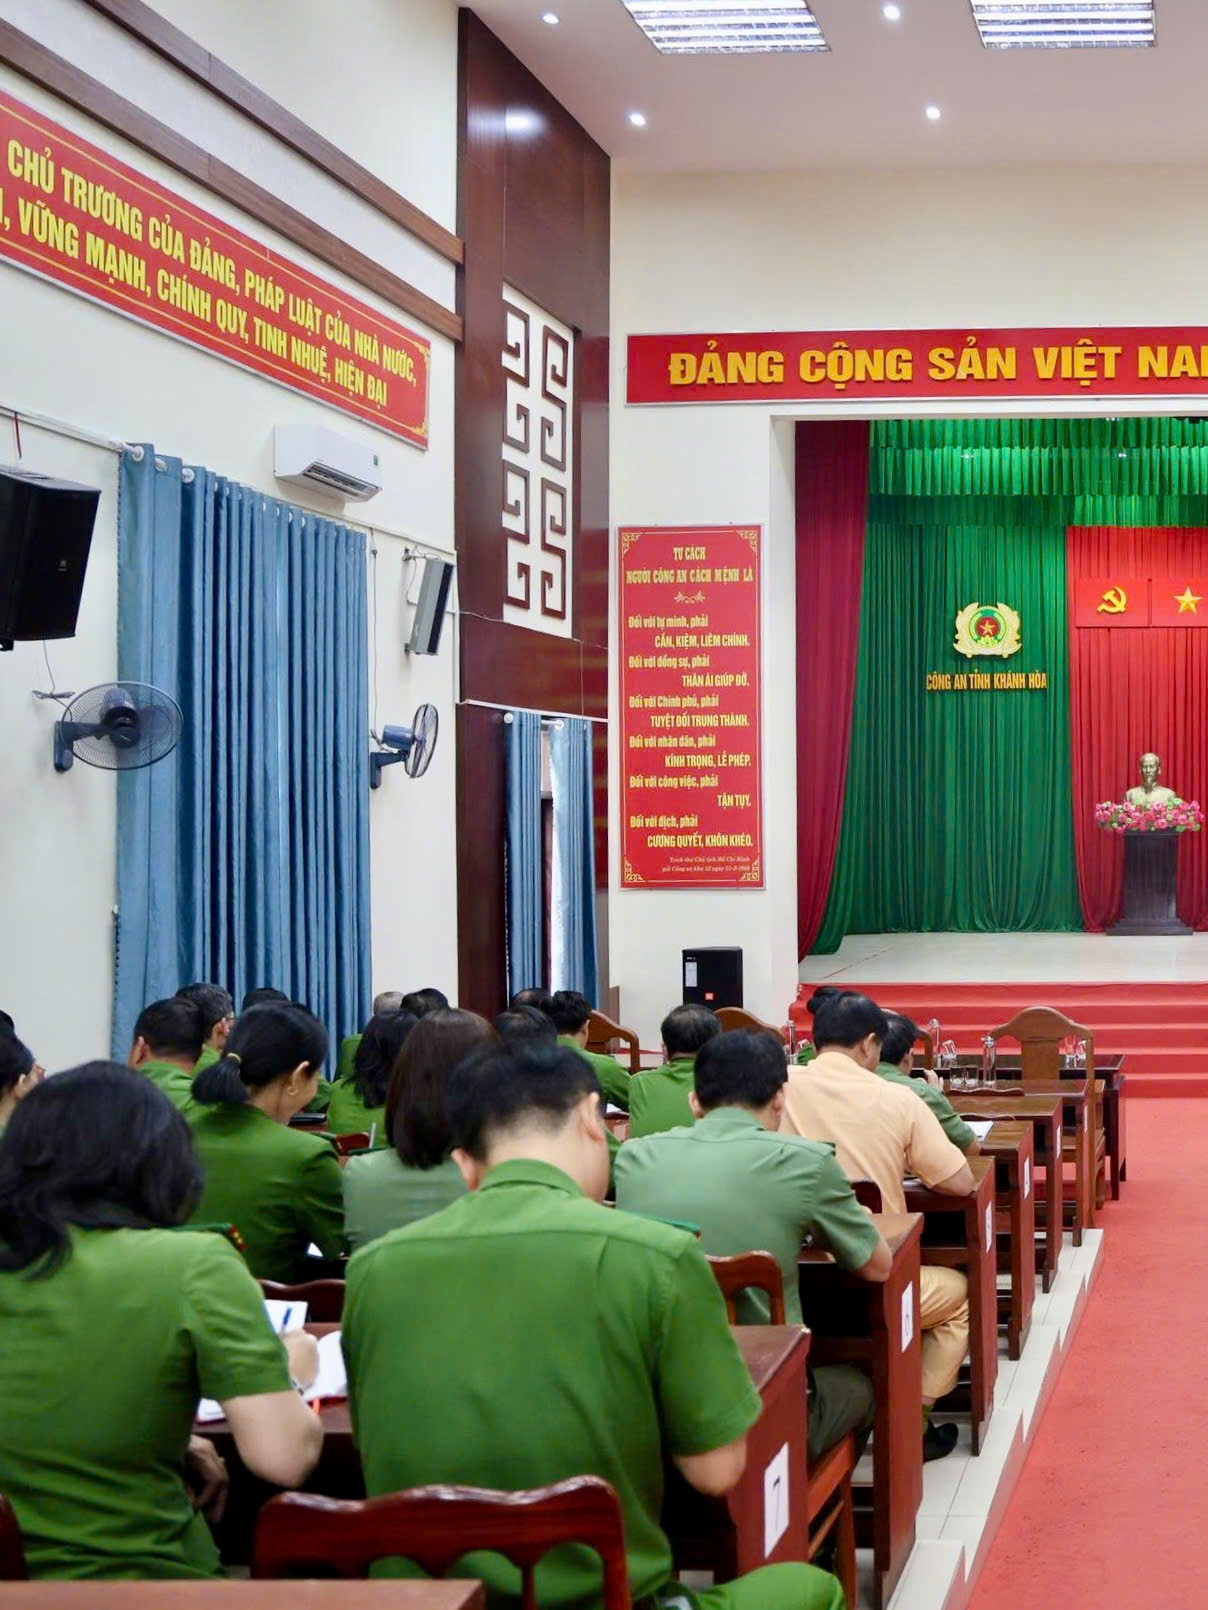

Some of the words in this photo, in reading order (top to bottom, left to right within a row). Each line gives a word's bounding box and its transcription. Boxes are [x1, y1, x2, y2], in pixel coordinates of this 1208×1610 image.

[8, 139, 54, 193] CHỦ
[61, 168, 142, 241] TRƯƠNG
[149, 215, 185, 263] CỦA
[189, 232, 240, 295] ĐẢNG,
[245, 269, 285, 313] PHÁP
[289, 295, 322, 334] LUẬT
[325, 314, 351, 349] CỦA
[354, 329, 380, 365] NHÀ
[381, 345, 416, 384] NƯỚC,
[18, 197, 79, 260] VỮNG
[86, 232, 151, 299] MẠNH,
[157, 269, 211, 323] CHÍNH
[216, 299, 248, 345] QUY,
[253, 316, 287, 360] TINH
[291, 336, 331, 383] NHUỆ,
[335, 357, 364, 396] HIỆN
[367, 374, 387, 406] ĐẠI
[669, 341, 783, 384] ĐẢNG
[800, 342, 912, 389] CỘNG
[929, 337, 1016, 379] SẢN
[1033, 339, 1121, 385] VIỆT
[926, 672, 951, 690] CÔNG
[954, 674, 967, 689] AN
[969, 668, 990, 689] TỈNH
[994, 670, 1026, 688] KHÁNH
[1028, 670, 1047, 688] HÒA
